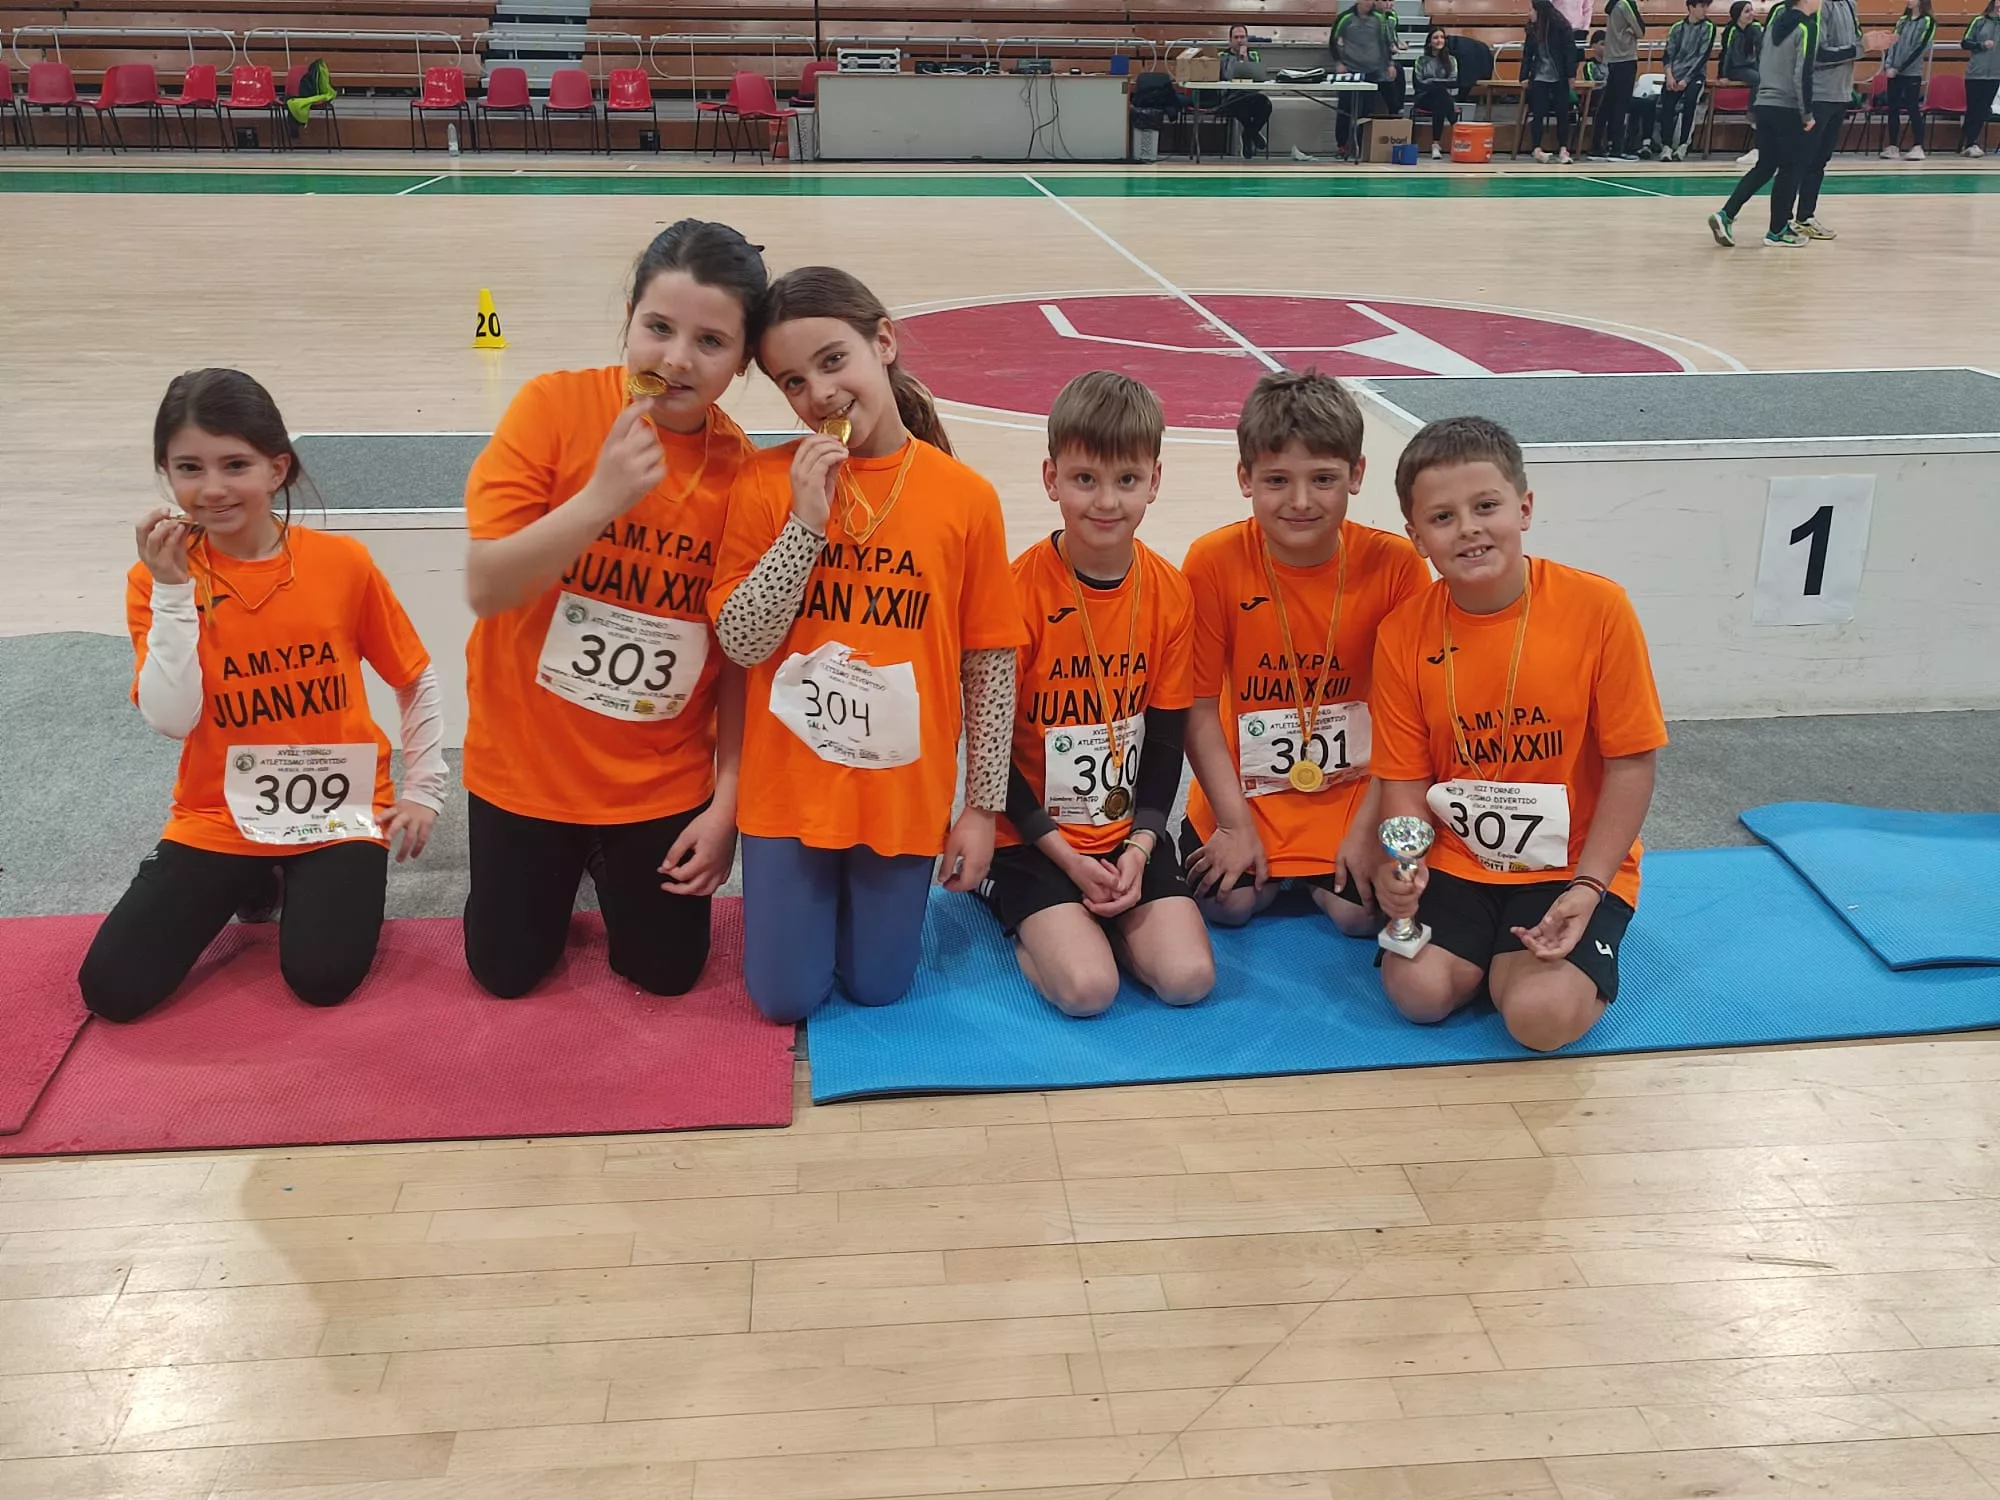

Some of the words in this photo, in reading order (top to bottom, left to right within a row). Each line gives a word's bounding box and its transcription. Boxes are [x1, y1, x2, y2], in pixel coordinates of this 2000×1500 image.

[476, 312, 501, 337] 20
[814, 542, 923, 578] .M.Y.P.A.
[1790, 505, 1834, 596] 1
[860, 585, 931, 630] XXIII
[571, 634, 677, 692] 303
[213, 683, 296, 729] JUAN
[801, 679, 871, 737] 304
[1027, 688, 1104, 725] JUAN
[1270, 720, 1310, 730] ATLETISO
[1270, 730, 1352, 775] 301
[1511, 729, 1563, 763] XXIII
[1072, 744, 1138, 796] 300
[1489, 786, 1521, 795] TORNEO
[255, 772, 350, 816] 309
[1493, 796, 1538, 805] DIVERTIDO
[1449, 801, 1544, 855] 307
